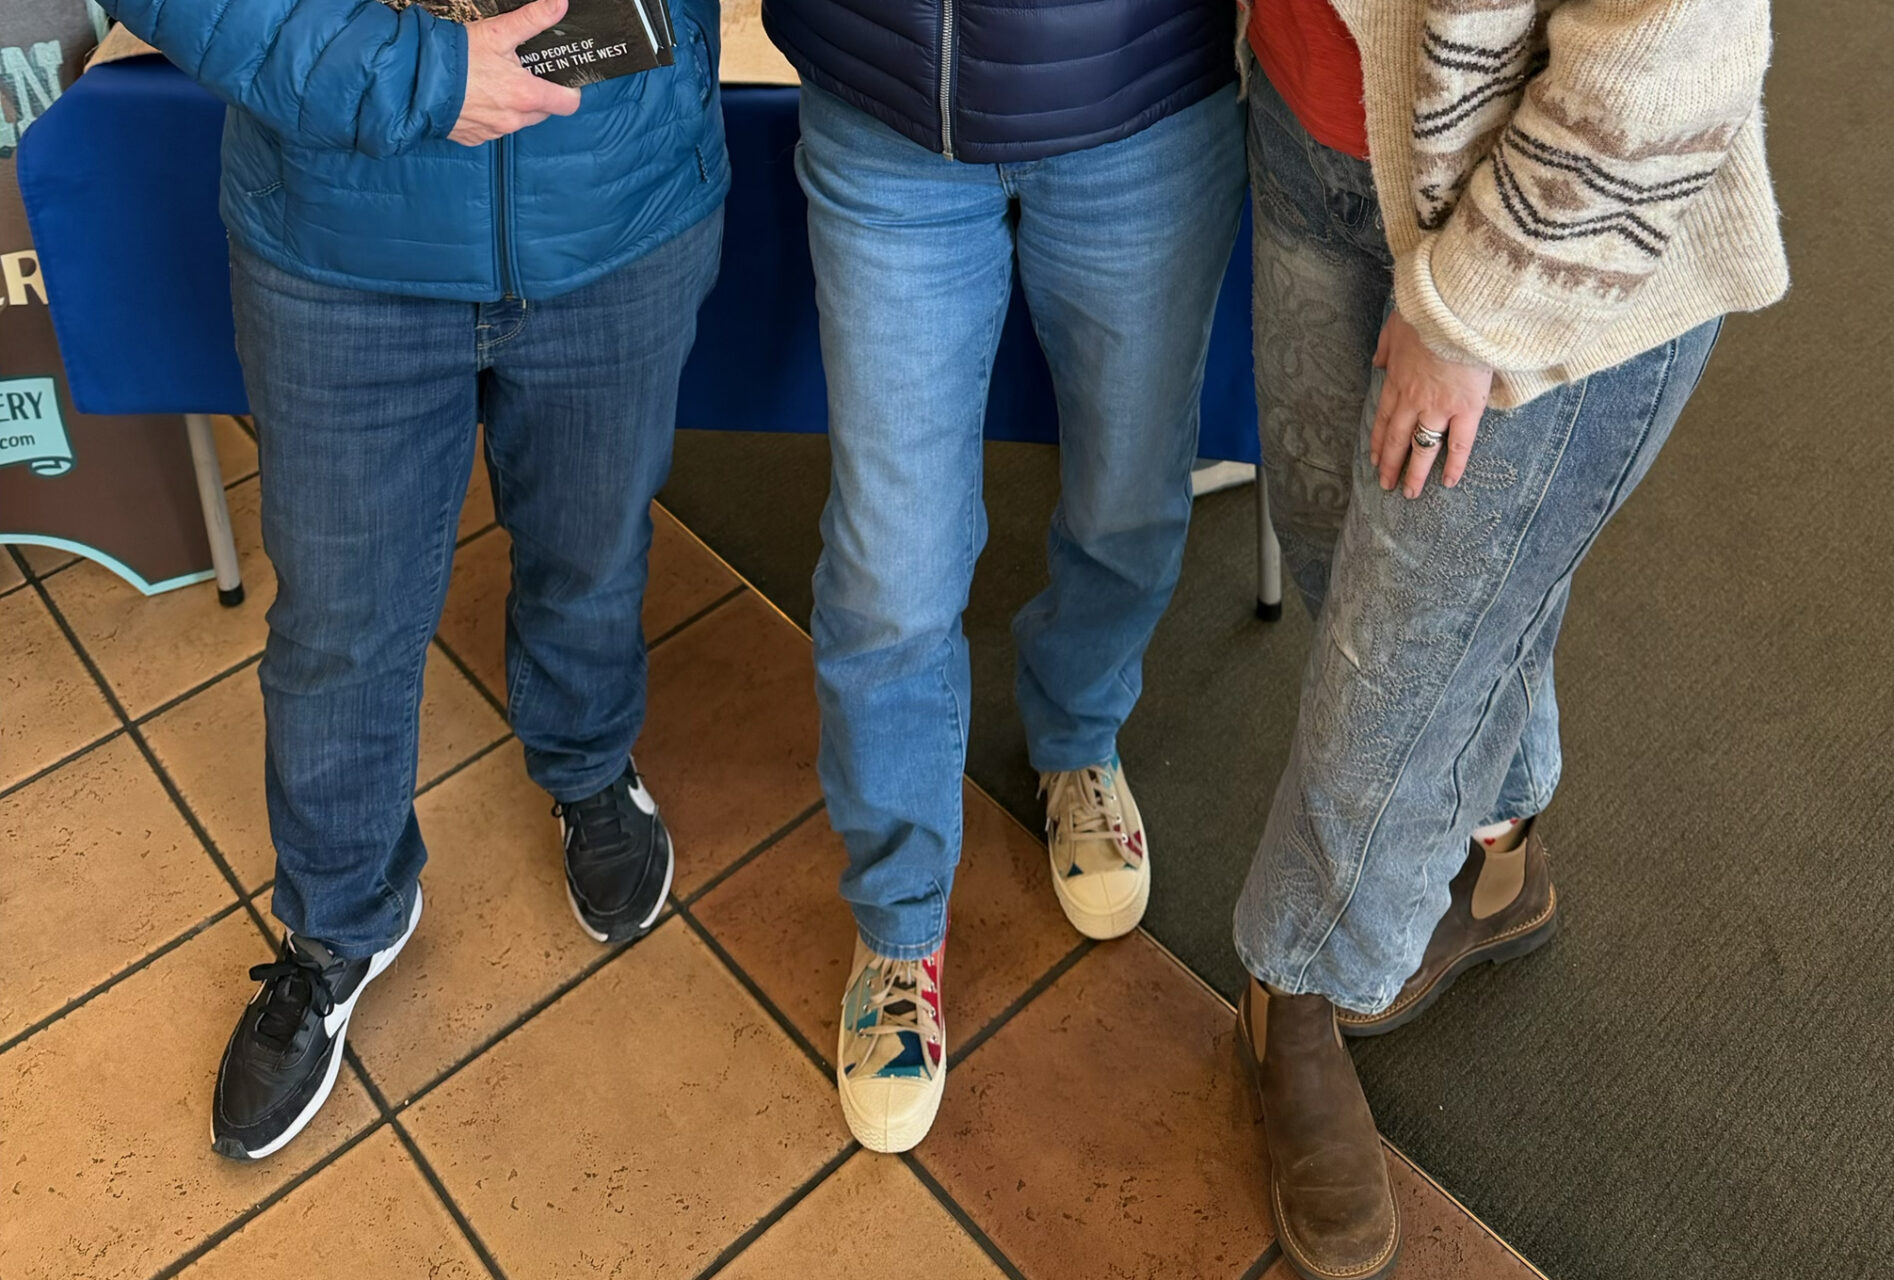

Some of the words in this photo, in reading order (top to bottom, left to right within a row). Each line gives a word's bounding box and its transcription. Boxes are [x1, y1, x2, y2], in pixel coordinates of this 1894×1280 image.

[520, 52, 540, 65] AND
[541, 42, 580, 61] PEOPLE
[581, 38, 595, 51] OF
[526, 62, 556, 76] TATE
[556, 58, 571, 70] IN
[571, 52, 597, 66] THE
[597, 43, 628, 61] WEST
[0, 249, 49, 306] R
